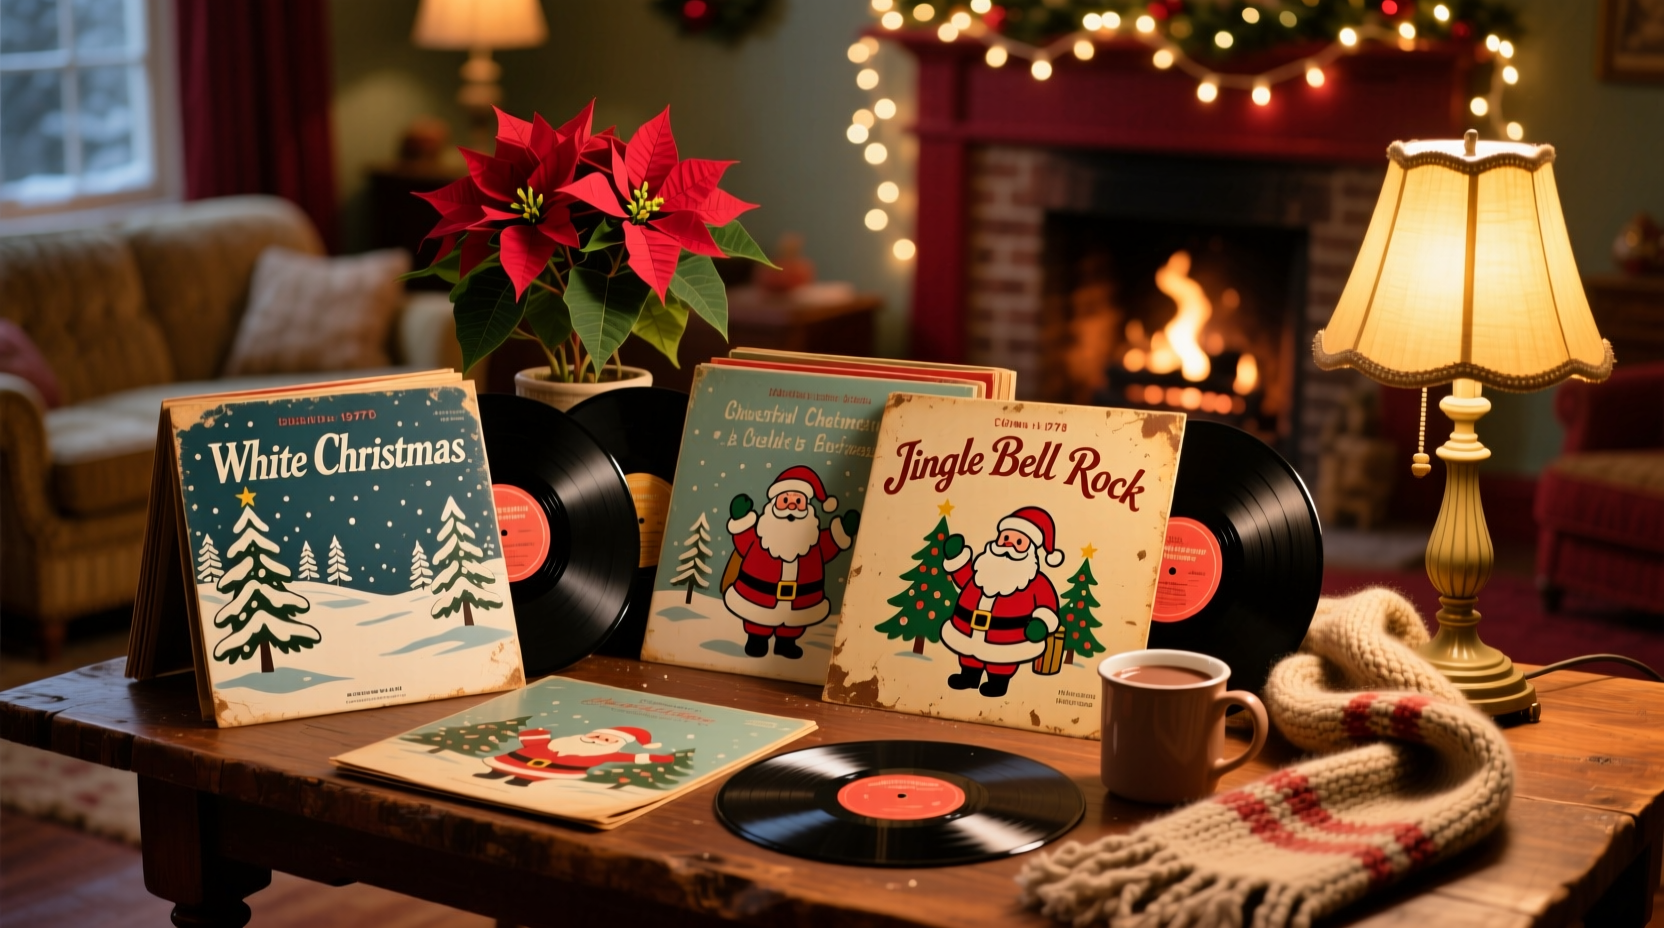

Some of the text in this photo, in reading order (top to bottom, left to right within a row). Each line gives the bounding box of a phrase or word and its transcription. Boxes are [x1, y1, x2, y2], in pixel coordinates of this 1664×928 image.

[208, 432, 466, 484] White Christmas
[883, 437, 985, 495] Jingle
[989, 435, 1063, 481] Bell
[1063, 446, 1145, 513] Rock
